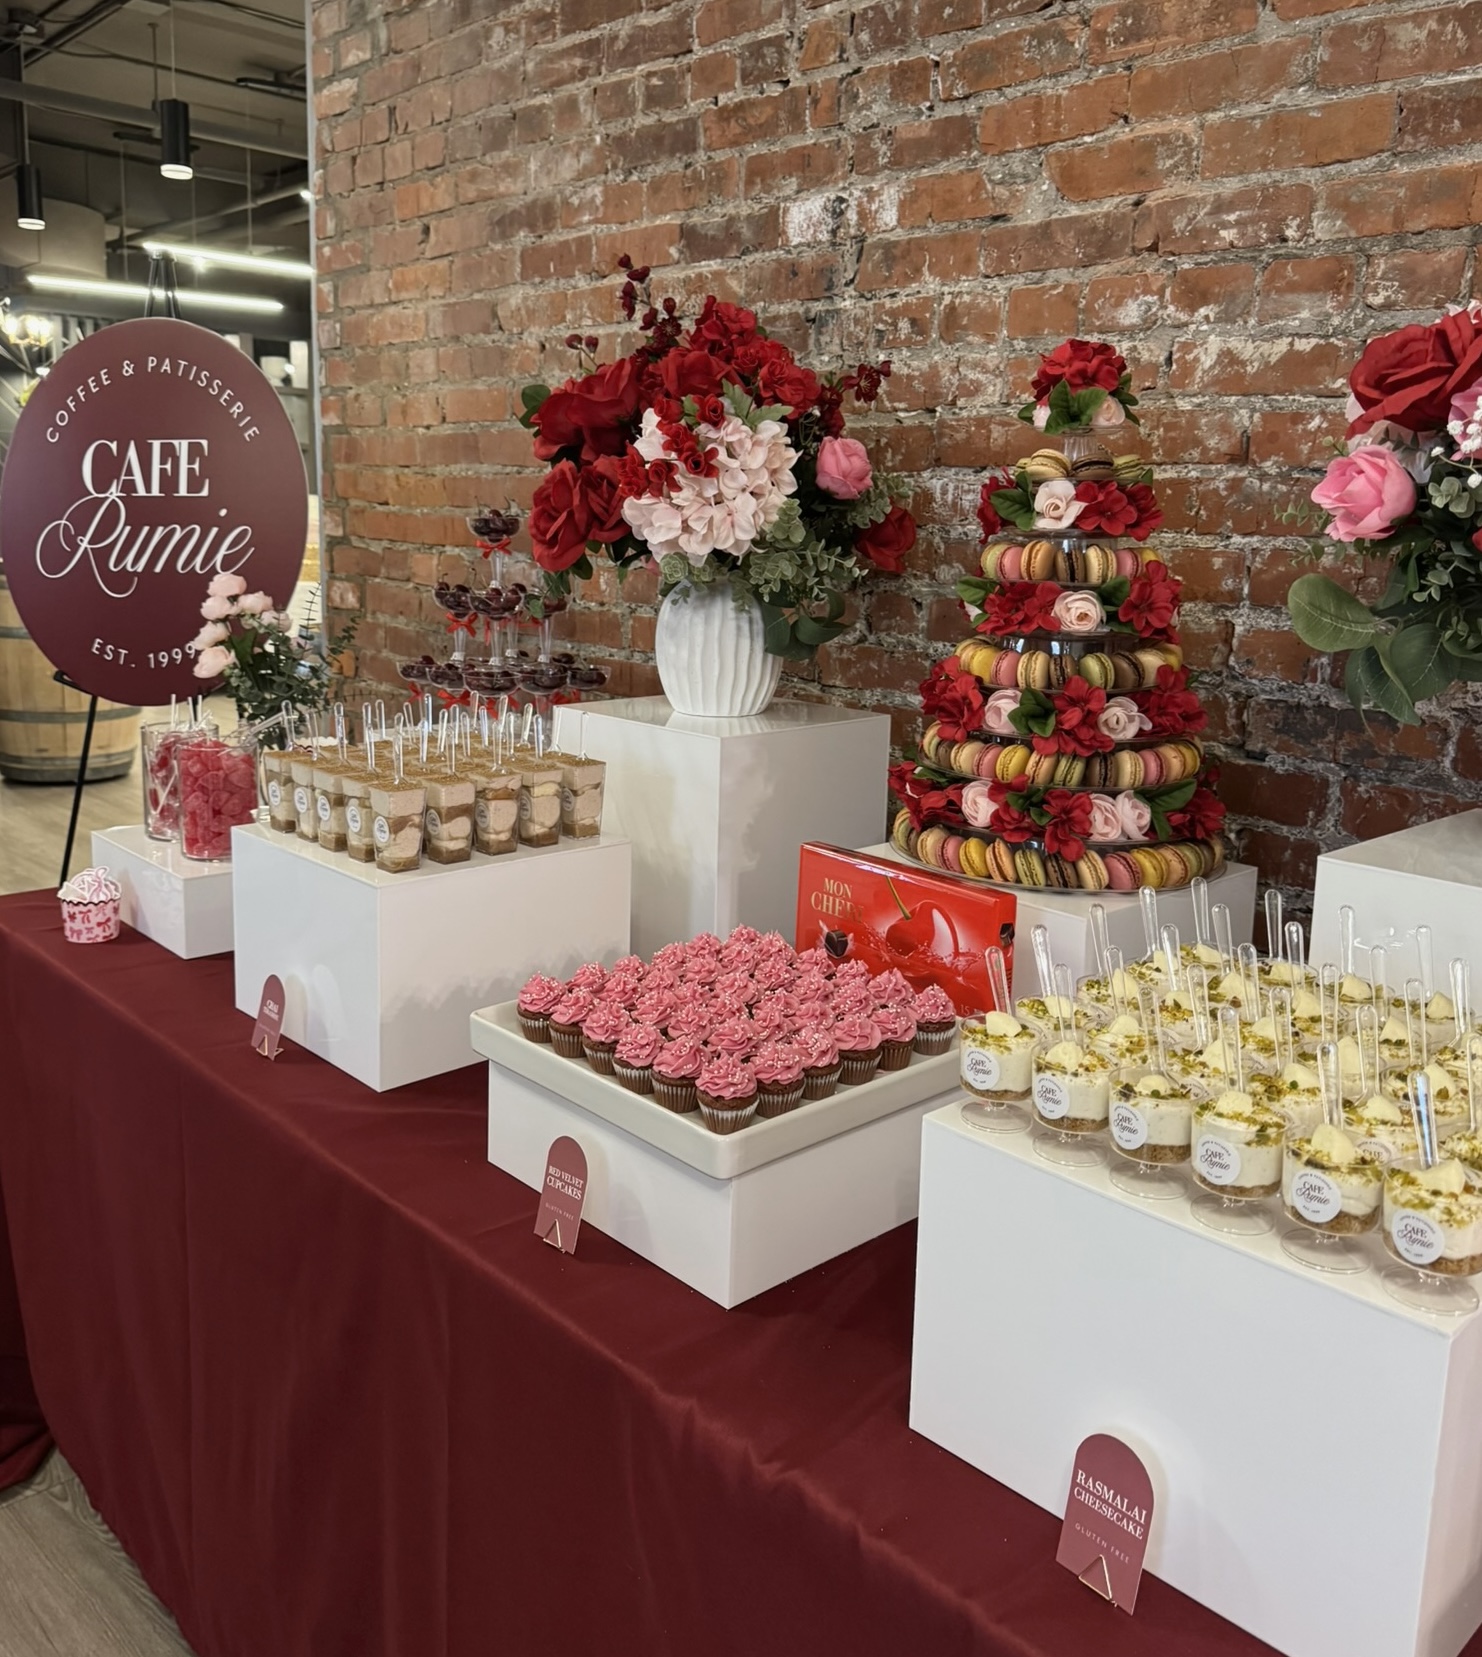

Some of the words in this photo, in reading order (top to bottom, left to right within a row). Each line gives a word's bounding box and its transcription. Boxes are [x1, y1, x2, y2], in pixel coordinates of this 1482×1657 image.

[45, 368, 112, 443] COFFEE
[121, 359, 135, 377] &
[147, 355, 260, 442] PATISSERIE
[81, 439, 209, 498] CAFE
[36, 494, 255, 598] Rumie
[91, 637, 137, 668] EST.
[147, 644, 197, 669] 1999
[823, 877, 853, 899] MON
[1205, 1148, 1224, 1160] CAFE
[547, 1176, 582, 1200] CUPCAKES
[549, 1166, 561, 1178] RED
[562, 1171, 584, 1188] VELVET
[1303, 1181, 1324, 1194] CAFE
[1074, 1486, 1144, 1540] CHEESECAKE
[1076, 1468, 1147, 1525] RASMALAI
[1075, 1522, 1108, 1549] GLUTEN
[1110, 1546, 1130, 1564] FREE
